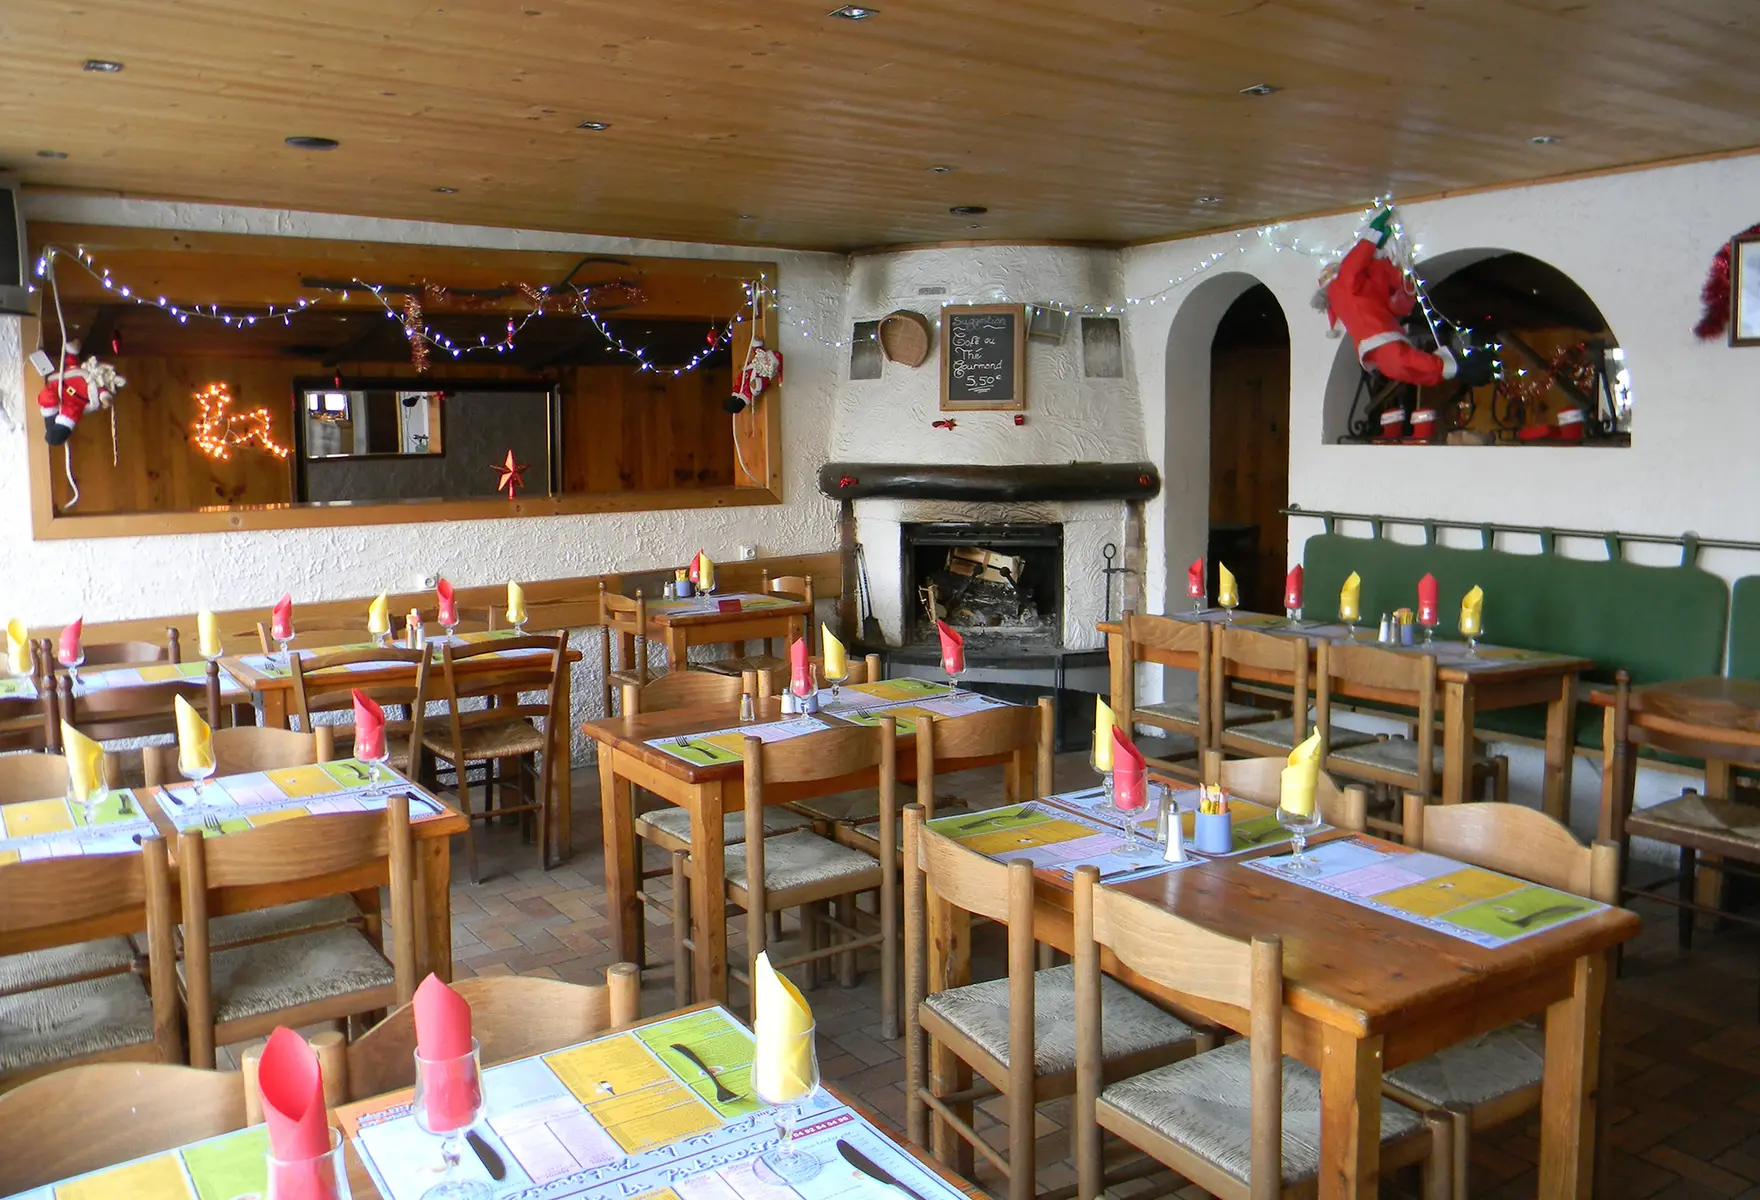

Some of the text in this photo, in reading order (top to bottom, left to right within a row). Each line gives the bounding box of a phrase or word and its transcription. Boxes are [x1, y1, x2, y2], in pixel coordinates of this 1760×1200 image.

[952, 316, 1005, 331] Suggstion
[984, 337, 996, 345] ou
[954, 347, 983, 360] Thé
[658, 1138, 779, 1182] Patinoire
